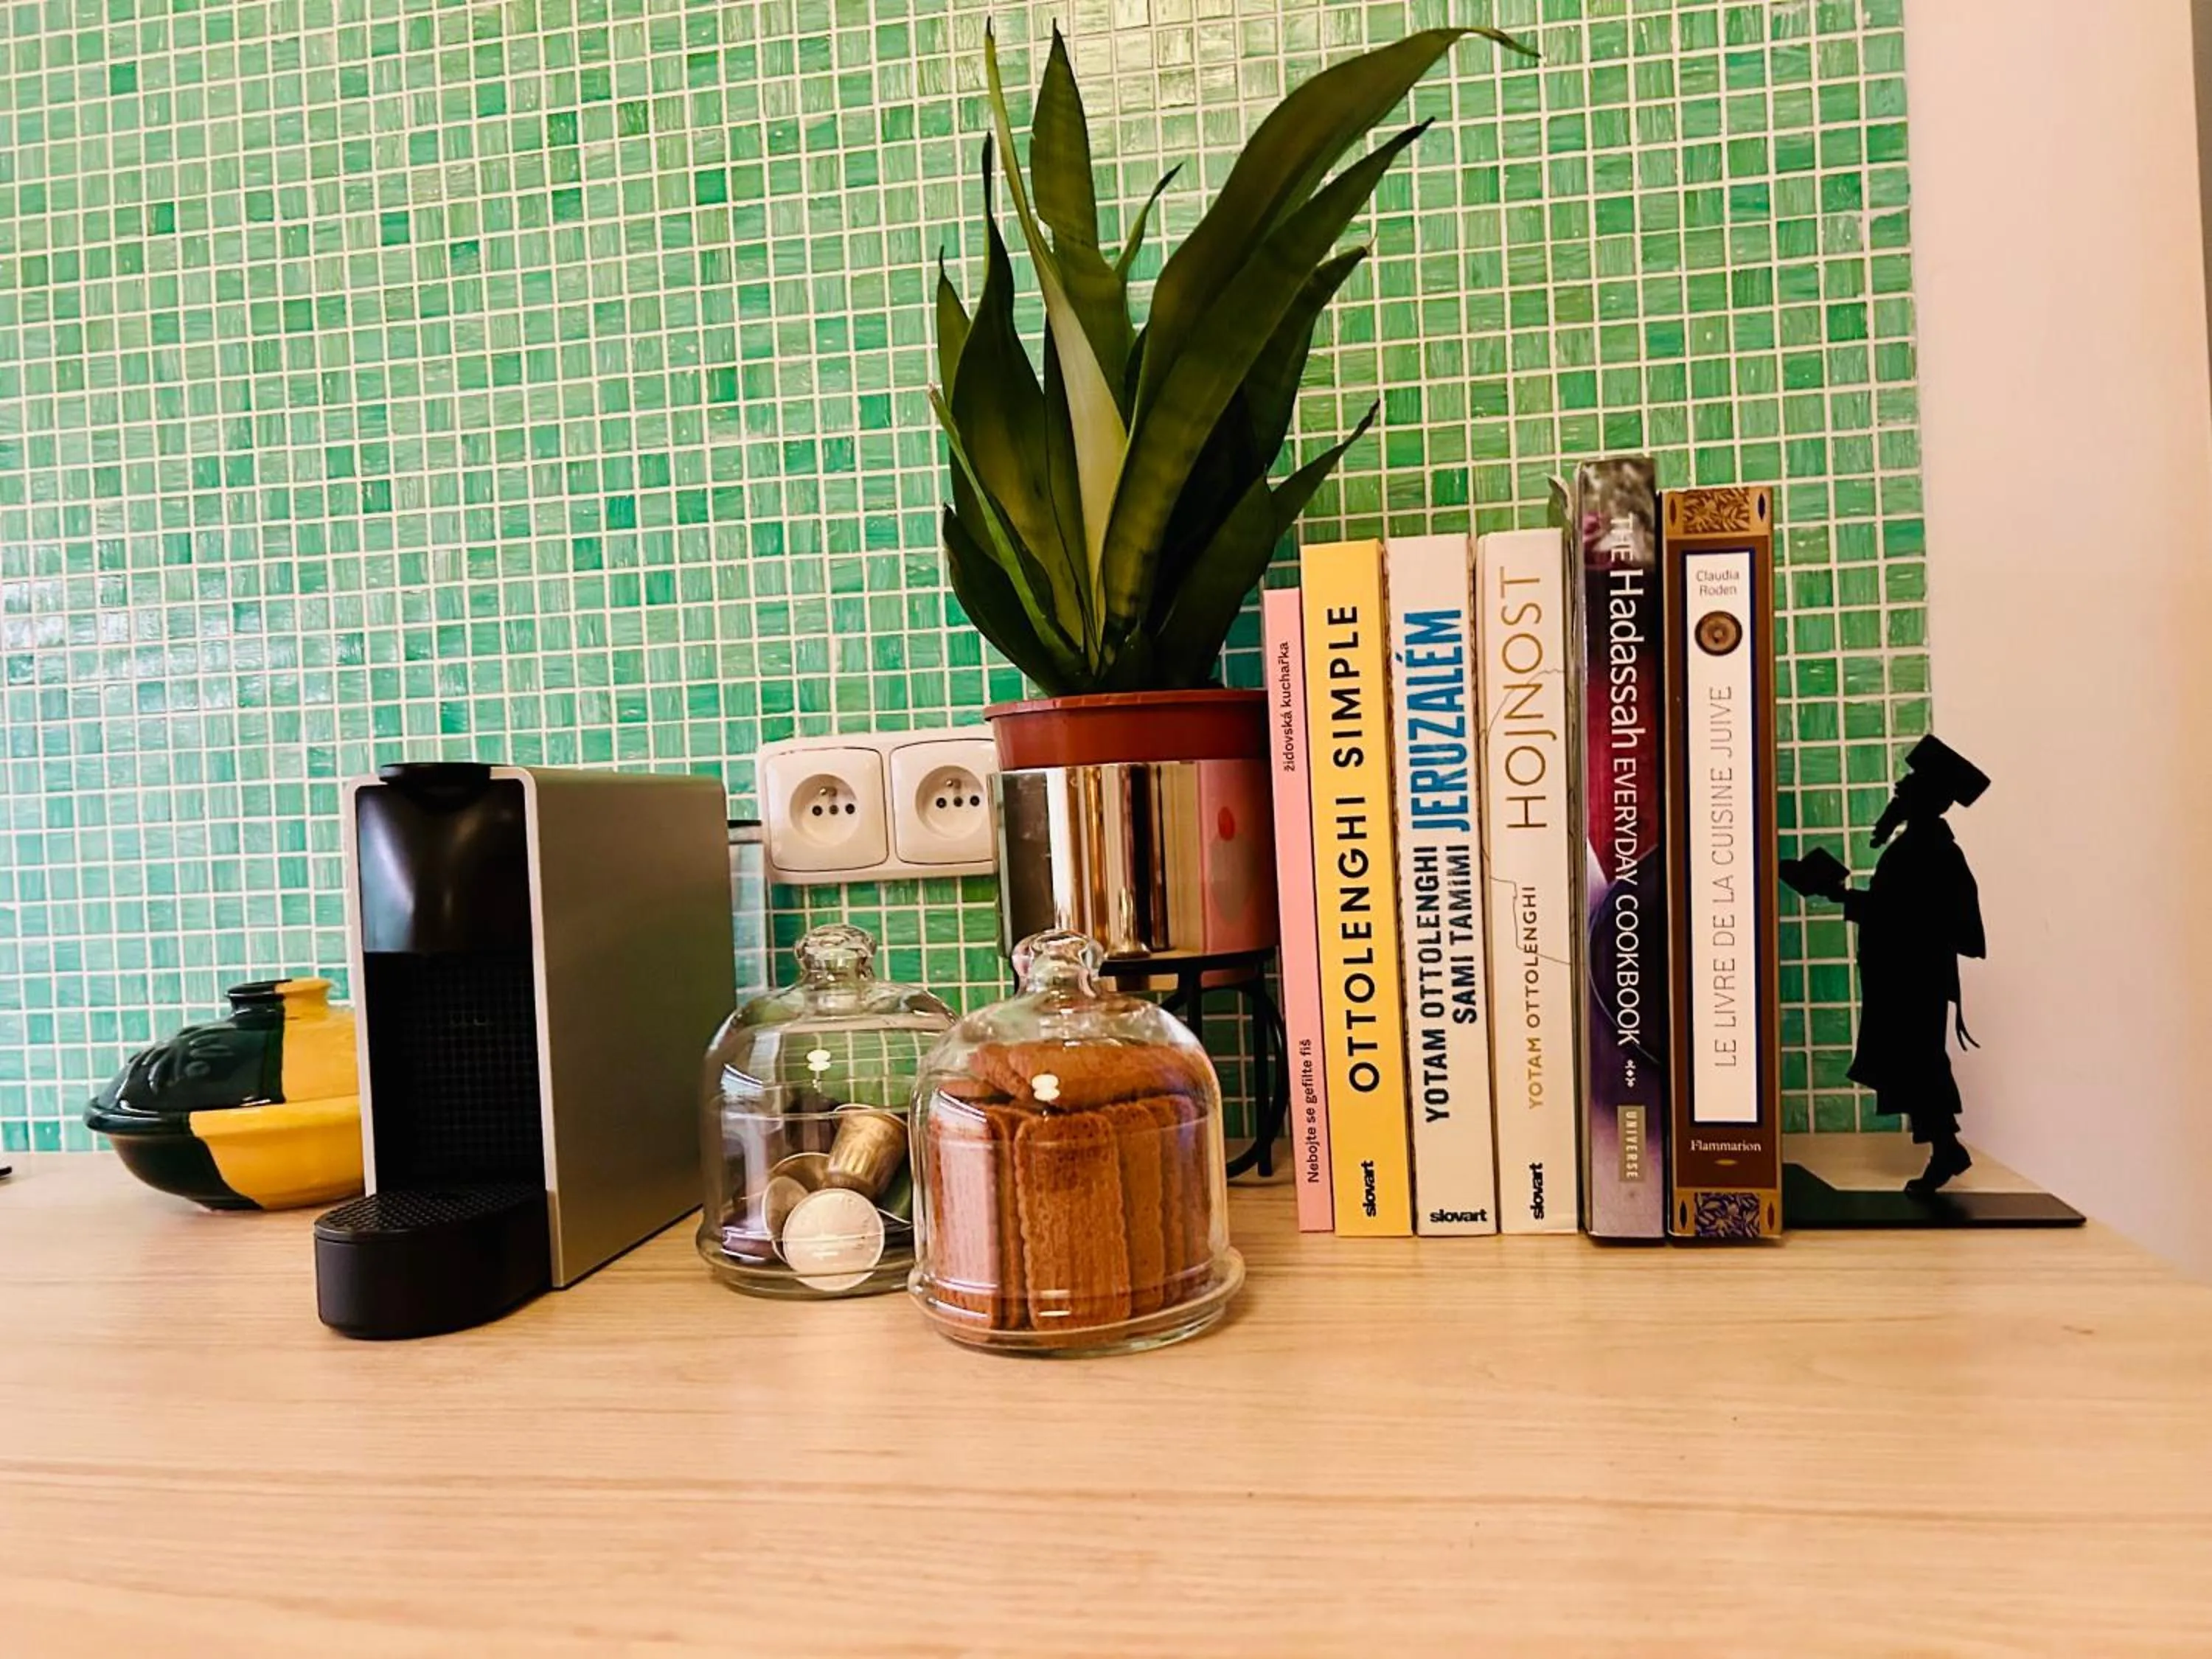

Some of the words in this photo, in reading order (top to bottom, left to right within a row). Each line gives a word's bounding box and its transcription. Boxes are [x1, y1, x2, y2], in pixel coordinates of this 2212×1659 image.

[1611, 512, 1633, 562] THE
[1696, 569, 1739, 581] Claudia
[1700, 584, 1737, 596] Roden
[1278, 641, 1292, 708] kuchařka
[1327, 606, 1364, 768] SIMPLE
[1610, 568, 1646, 748] Hadassah
[1396, 609, 1470, 832] JERUZALÉM
[1500, 566, 1557, 829] HOJNOST
[1709, 686, 1732, 759] JUIVE
[1280, 711, 1295, 772] židovská
[1613, 758, 1638, 885] EVERYDAY
[1711, 768, 1734, 866] CUISINE
[1712, 874, 1735, 903] LA
[1335, 797, 1380, 1093] OTTOLENGHI
[1413, 846, 1444, 1018] OTTOLENGHI
[1522, 887, 1541, 1029] OTTOLENGHI
[1712, 914, 1735, 946] DE
[1450, 956, 1478, 1023] SAMI
[1615, 894, 1640, 1046] COOKBOOK
[1713, 959, 1736, 1027] LIVRE
[1299, 1039, 1312, 1056] fiš
[1422, 1029, 1450, 1122] YOTAM
[1528, 1037, 1543, 1109] YOTAM
[1714, 1040, 1736, 1067] LE
[1301, 1060, 1318, 1104] gefilte
[1306, 1108, 1316, 1123] se
[1305, 1127, 1320, 1183] Nebojte
[1625, 1111, 1638, 1178] UNIVERSE
[1691, 1139, 1761, 1151] Flammarion
[1361, 1160, 1376, 1217] slovart
[1430, 1208, 1487, 1222] slovart
[1528, 1162, 1544, 1220] slovart
